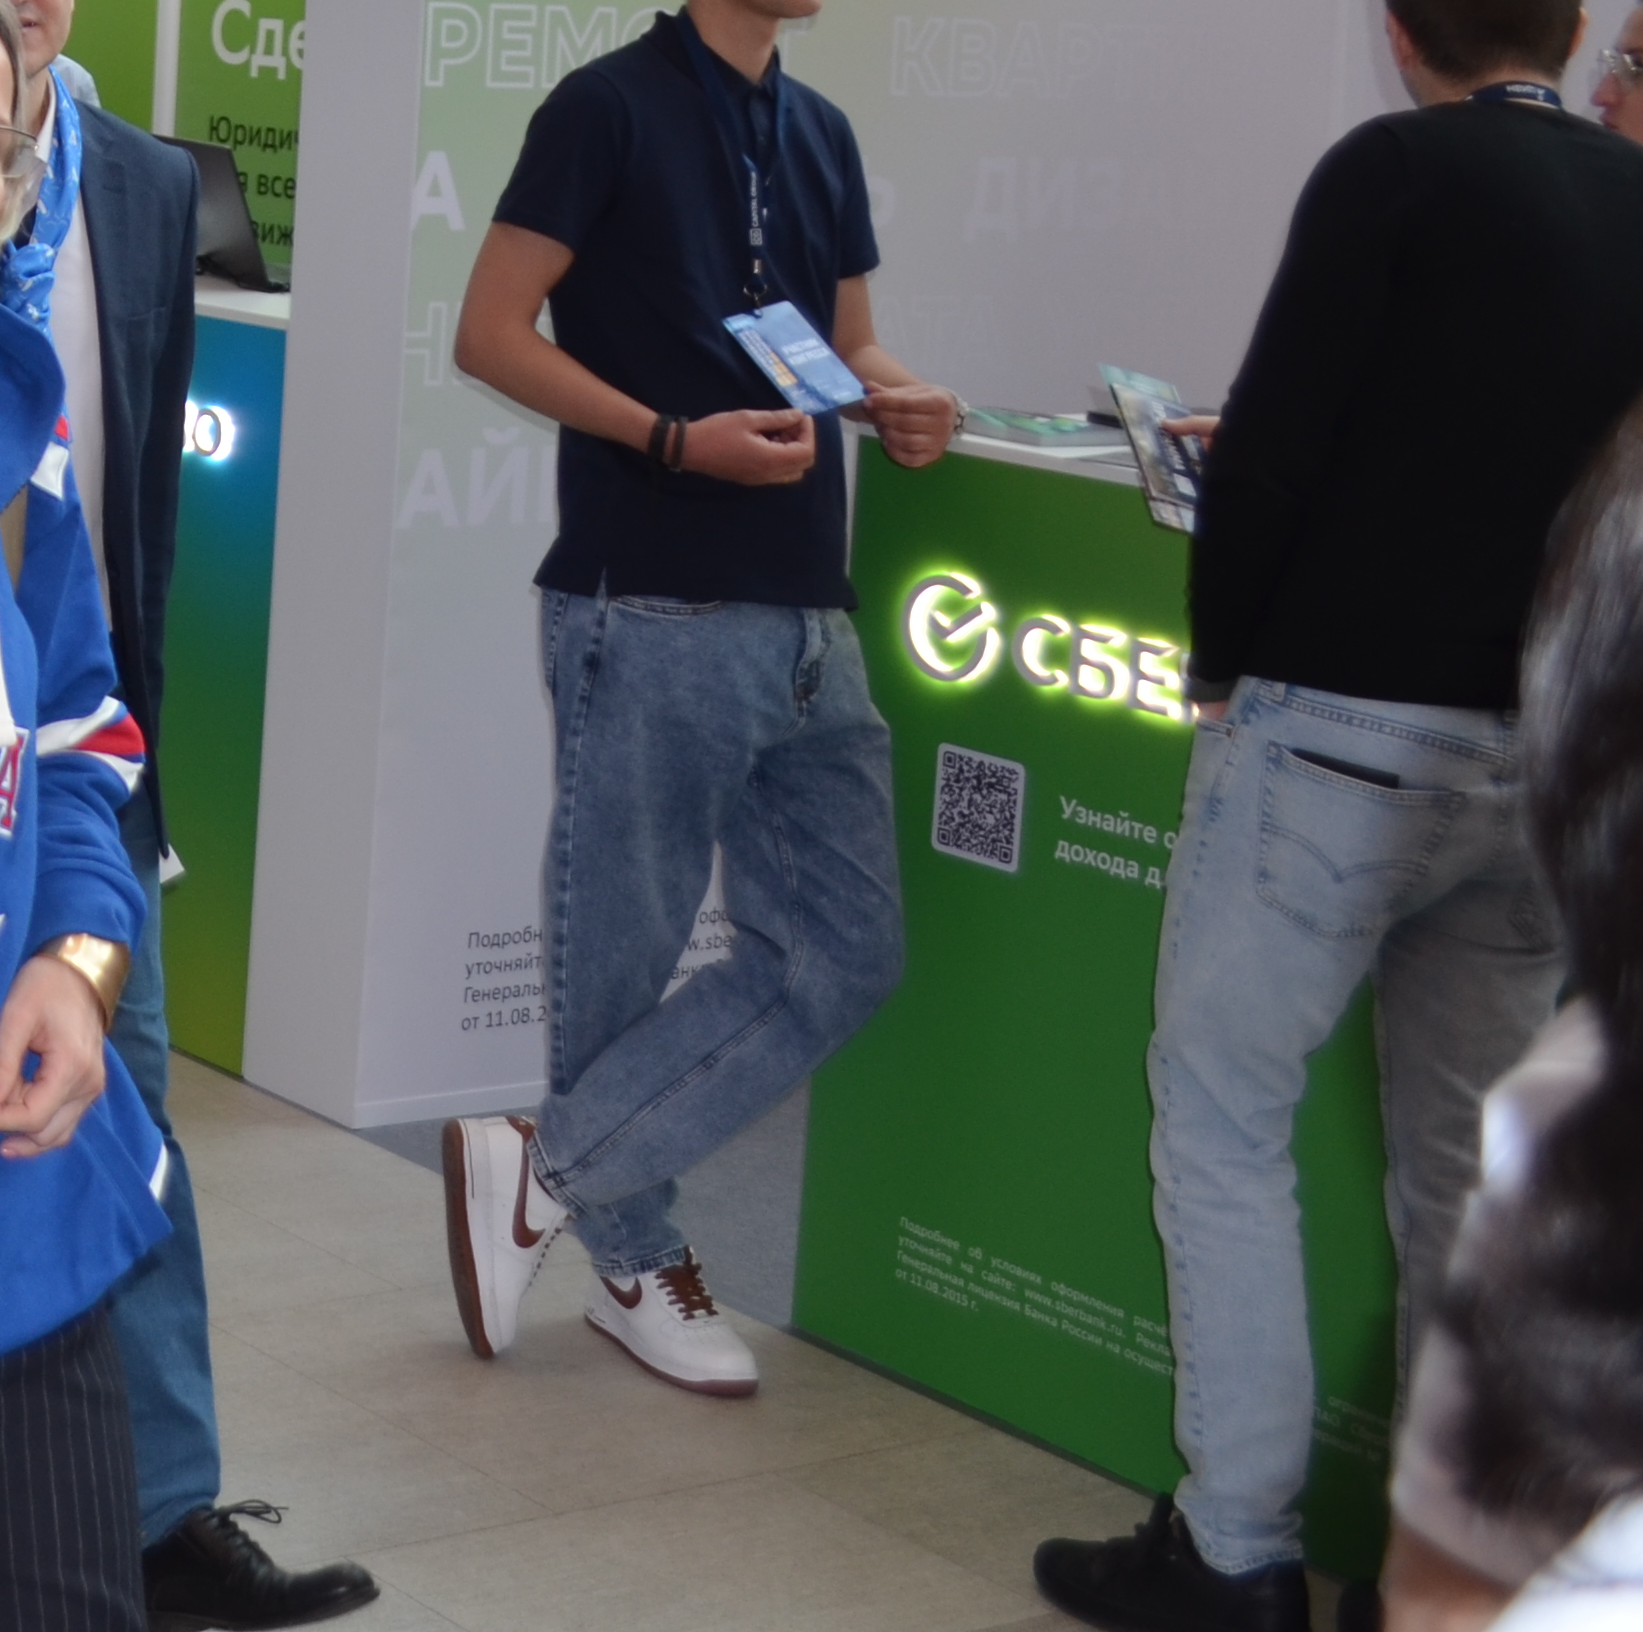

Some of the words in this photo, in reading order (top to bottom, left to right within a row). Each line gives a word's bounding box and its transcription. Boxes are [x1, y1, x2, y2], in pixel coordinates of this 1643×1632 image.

[208, 115, 299, 152] Юриди
[1012, 614, 1197, 724] СБЕ
[1059, 794, 1158, 844] Узнайте
[1054, 839, 1139, 880] дохода
[461, 1013, 479, 1032] от
[898, 1235, 953, 1265] уточняйте
[961, 1260, 975, 1274] на
[900, 1216, 960, 1251] Подробнее
[968, 1246, 983, 1260] об
[991, 1256, 1042, 1285] условиях
[1051, 1281, 1125, 1318] оформления
[895, 1268, 908, 1282] от
[911, 1272, 968, 1307] 11.08.2015
[897, 1250, 965, 1287] Генеральная
[967, 1281, 1021, 1311] лицензия
[1024, 1303, 1058, 1329] Банка
[1062, 1318, 1103, 1346] России
[1106, 1339, 1120, 1354] на
